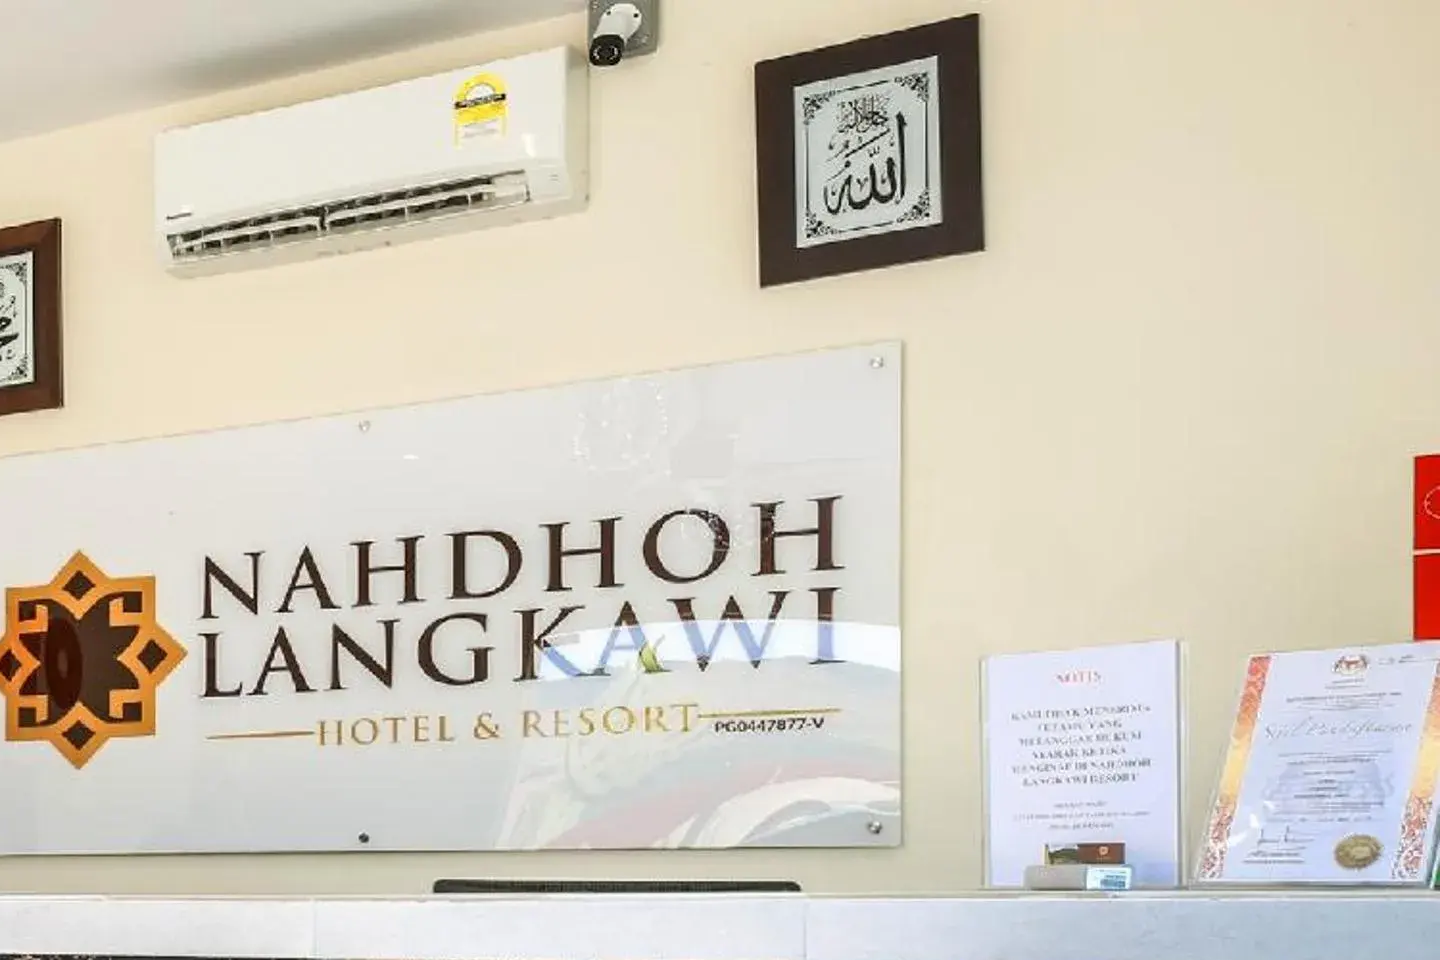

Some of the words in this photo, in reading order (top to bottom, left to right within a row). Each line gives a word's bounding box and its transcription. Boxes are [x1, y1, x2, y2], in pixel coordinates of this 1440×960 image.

[200, 494, 845, 620] NAHDHOH
[200, 586, 846, 699] LANGKAWI
[316, 714, 456, 747] HOTEL
[473, 711, 500, 740] &
[521, 702, 699, 739] RESORT
